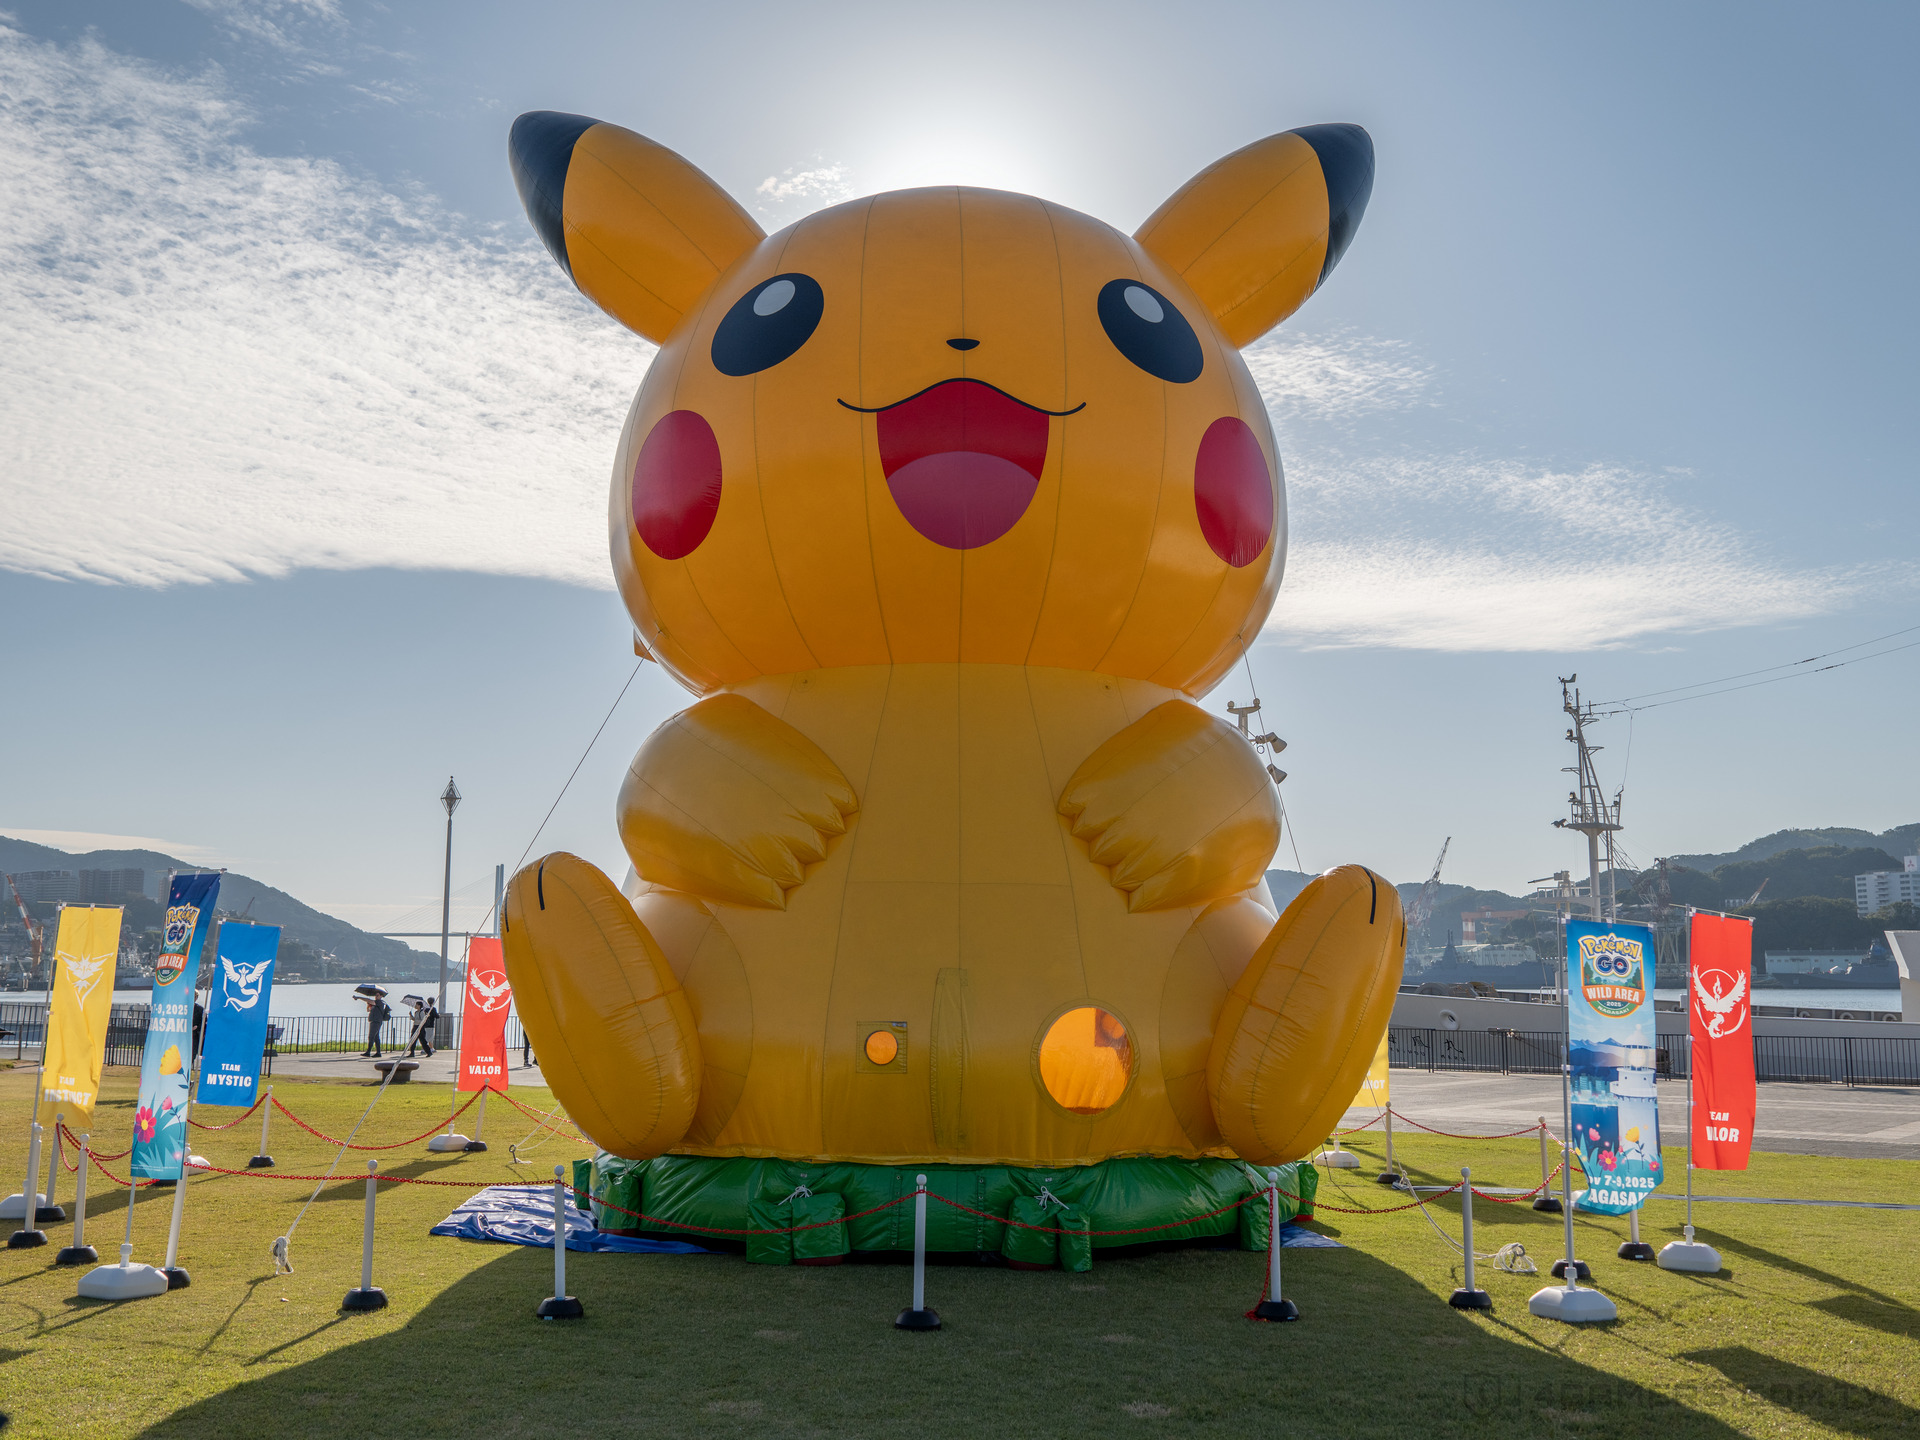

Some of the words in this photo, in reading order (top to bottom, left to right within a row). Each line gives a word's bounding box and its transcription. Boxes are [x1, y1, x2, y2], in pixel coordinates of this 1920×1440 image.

[168, 923, 187, 943] GO
[168, 955, 184, 970] AREA
[1595, 954, 1629, 976] GO
[1586, 987, 1612, 1000] WILD
[1614, 987, 1640, 1003] AREA
[1597, 1005, 1630, 1015] NAGASAKI
[476, 1055, 494, 1063] TEAM
[221, 1063, 241, 1072] TEAM
[468, 1065, 502, 1075] VALOR
[206, 1073, 252, 1088] MYSTIC
